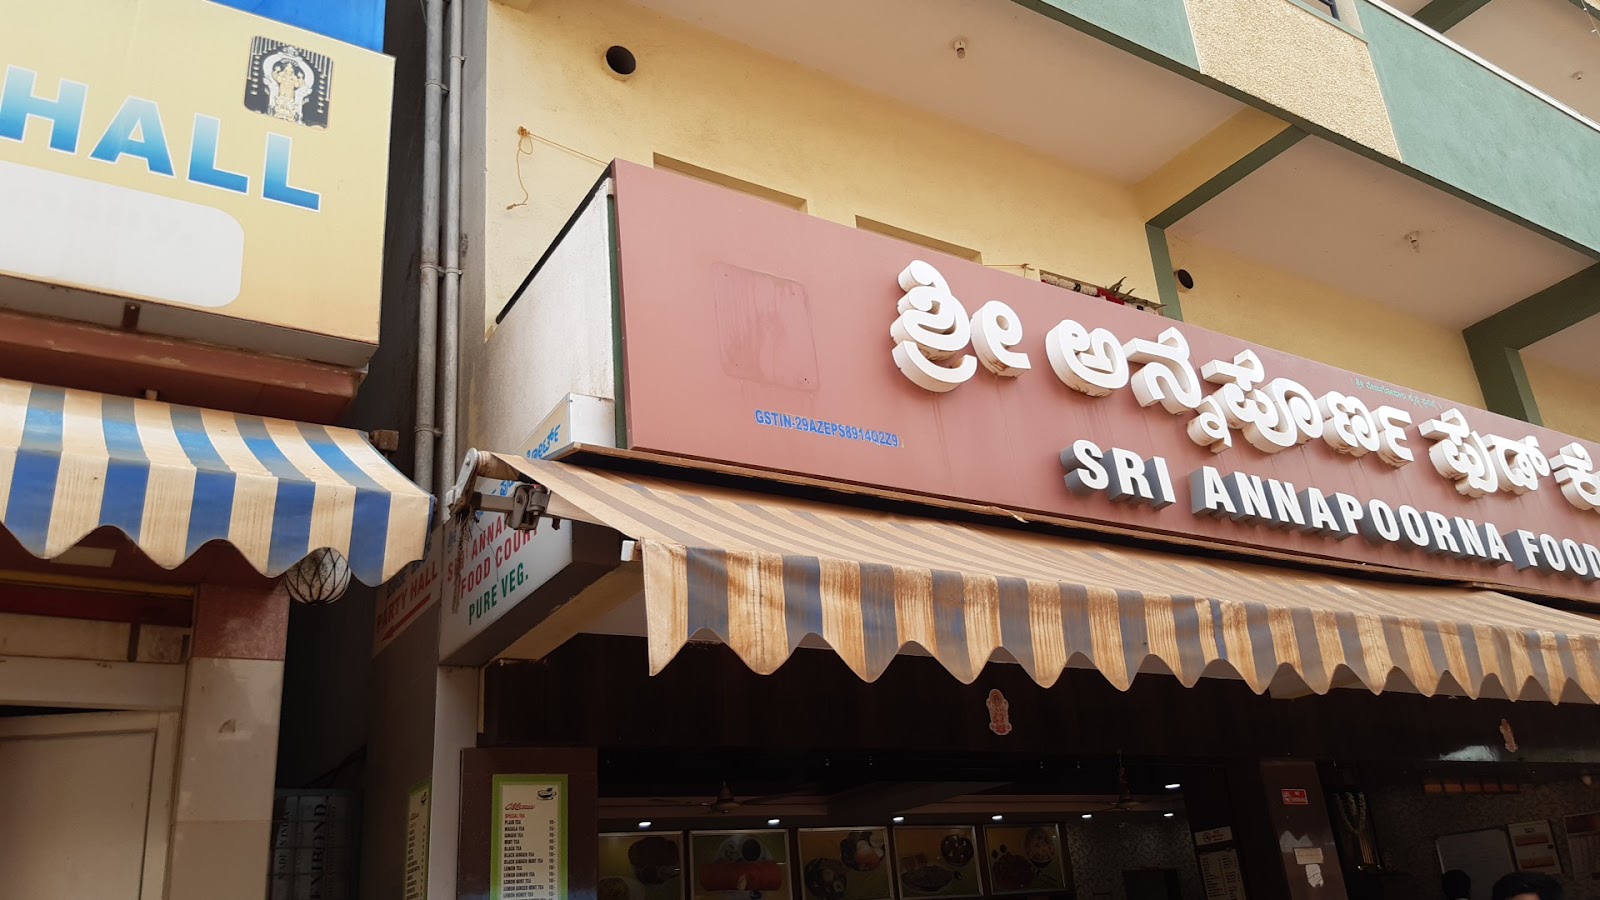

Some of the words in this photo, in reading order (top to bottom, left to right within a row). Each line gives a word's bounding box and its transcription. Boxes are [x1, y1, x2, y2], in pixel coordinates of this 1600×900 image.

[0, 65, 320, 213] HALL
[889, 259, 1032, 393] ಶ್ರೀ
[1045, 318, 1415, 468] ಅನ್ನಪೂರ್ಣ
[1061, 438, 1177, 506] SRI
[1189, 466, 1513, 566] ANNAPOORNA
[376, 587, 408, 633] PARTY
[410, 560, 438, 601] HALL
[460, 556, 491, 600] FOOD
[469, 583, 497, 626] PURE
[501, 562, 529, 599] VEG.
[504, 802, 535, 810] Menu
